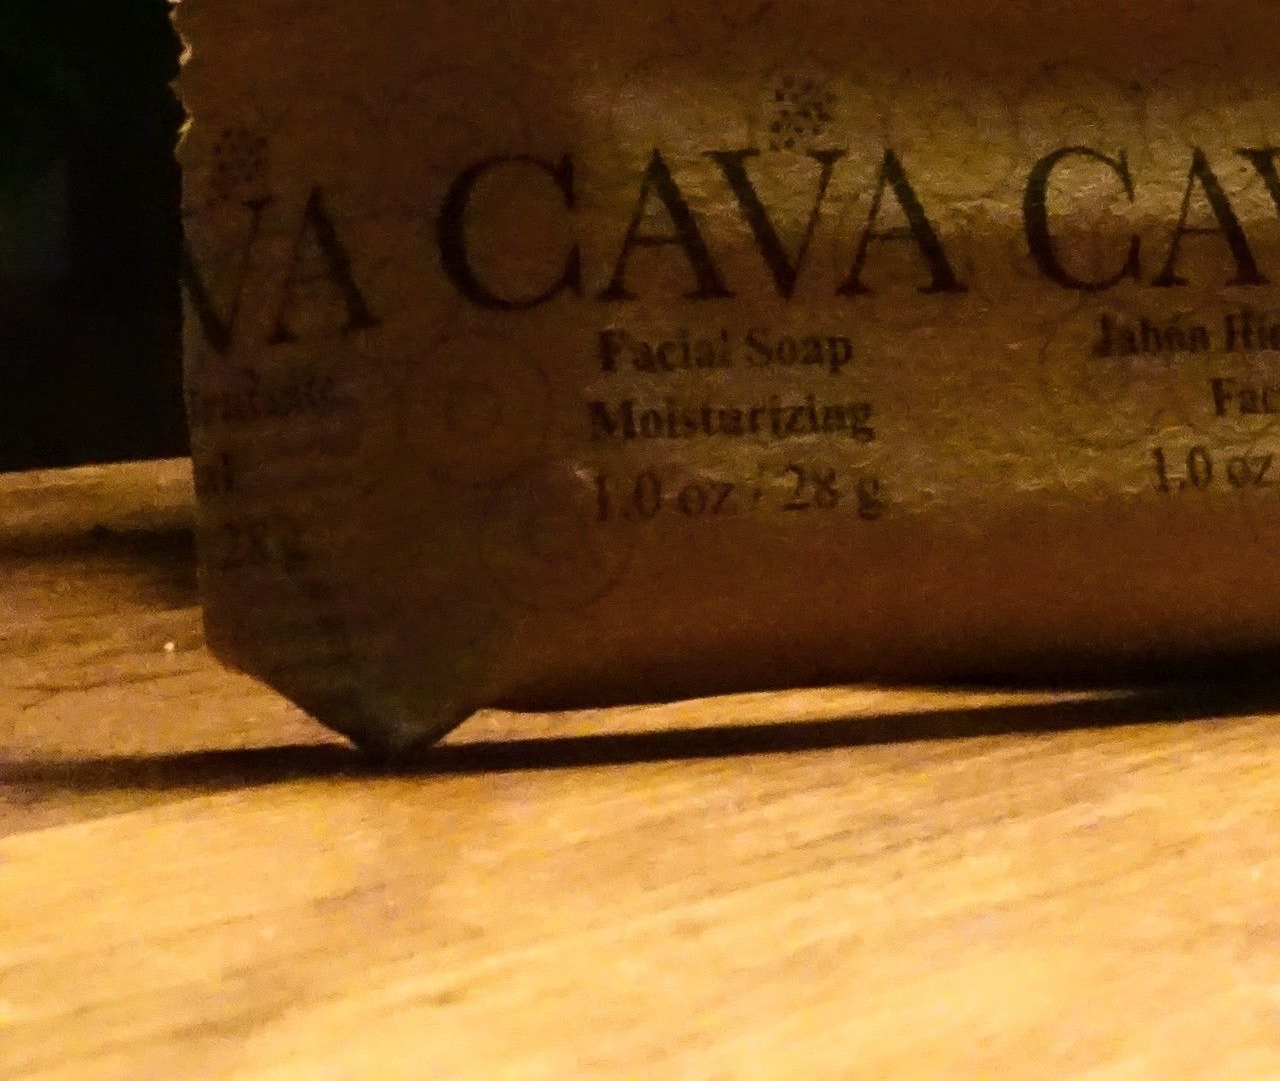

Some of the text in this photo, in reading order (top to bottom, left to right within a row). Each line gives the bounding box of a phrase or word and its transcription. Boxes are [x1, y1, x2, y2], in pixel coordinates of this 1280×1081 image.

[434, 145, 970, 313] CAVA
[597, 323, 855, 373] Facial Soap
[1092, 315, 1211, 357] Jabón
[587, 393, 876, 443] Moisturizing
[595, 471, 662, 521] 1.0
[677, 481, 738, 517] oz
[780, 462, 842, 511] 28
[855, 477, 888, 521] g
[1152, 444, 1214, 495] 1.0
[1226, 453, 1276, 489] oz
